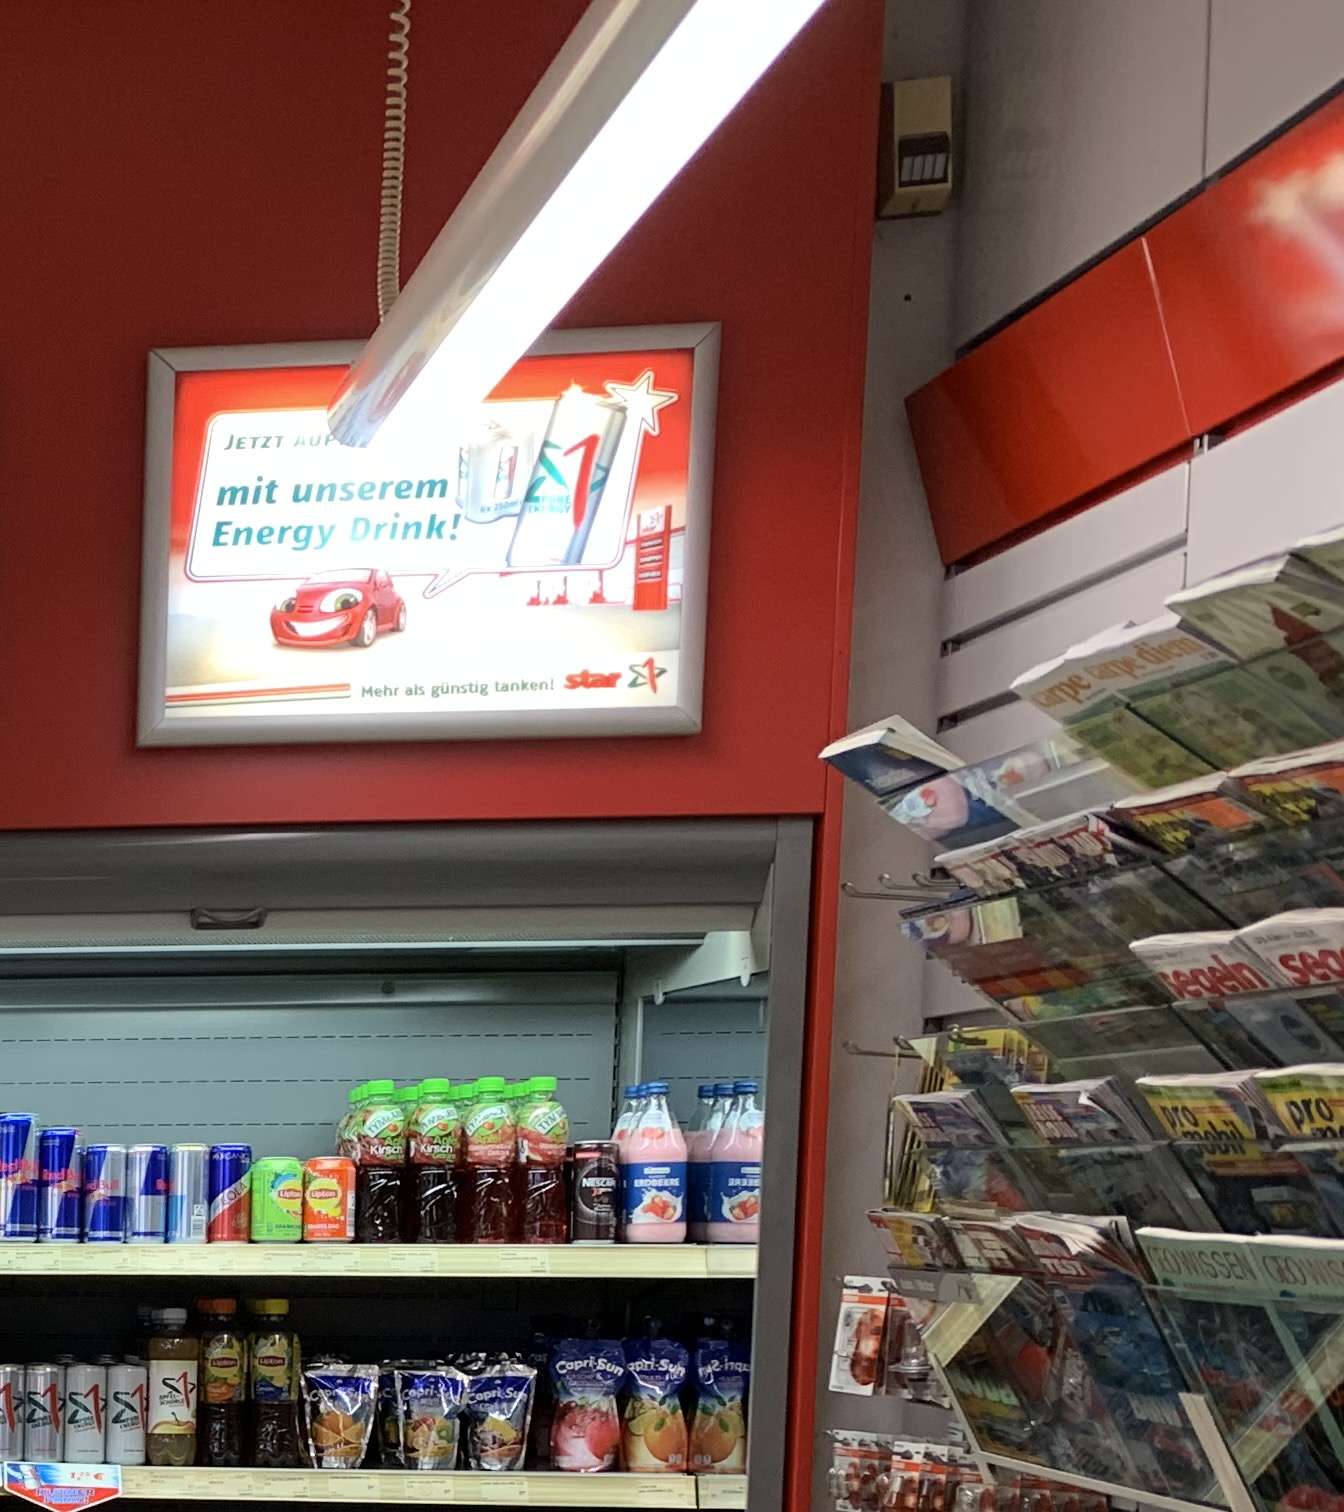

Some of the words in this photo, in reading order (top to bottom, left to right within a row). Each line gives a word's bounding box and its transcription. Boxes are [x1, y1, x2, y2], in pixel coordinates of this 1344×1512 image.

[224, 434, 284, 450] JETZT
[216, 476, 277, 507] mit
[292, 478, 447, 502] unserem
[212, 522, 335, 551] Energy
[350, 514, 460, 543] Drink!
[361, 684, 400, 698] Mehr
[405, 682, 426, 695] als
[430, 680, 489, 697] günstig
[493, 678, 553, 694] tanken!
[563, 669, 621, 689] star
[1161, 1106, 1199, 1135] pro
[1286, 1098, 1334, 1134] pro
[369, 1145, 403, 1156] Kirsch
[420, 1143, 453, 1155] Kirsch
[1182, 1252, 1258, 1280] WISSEN
[556, 1358, 623, 1375] Capri-Sun
